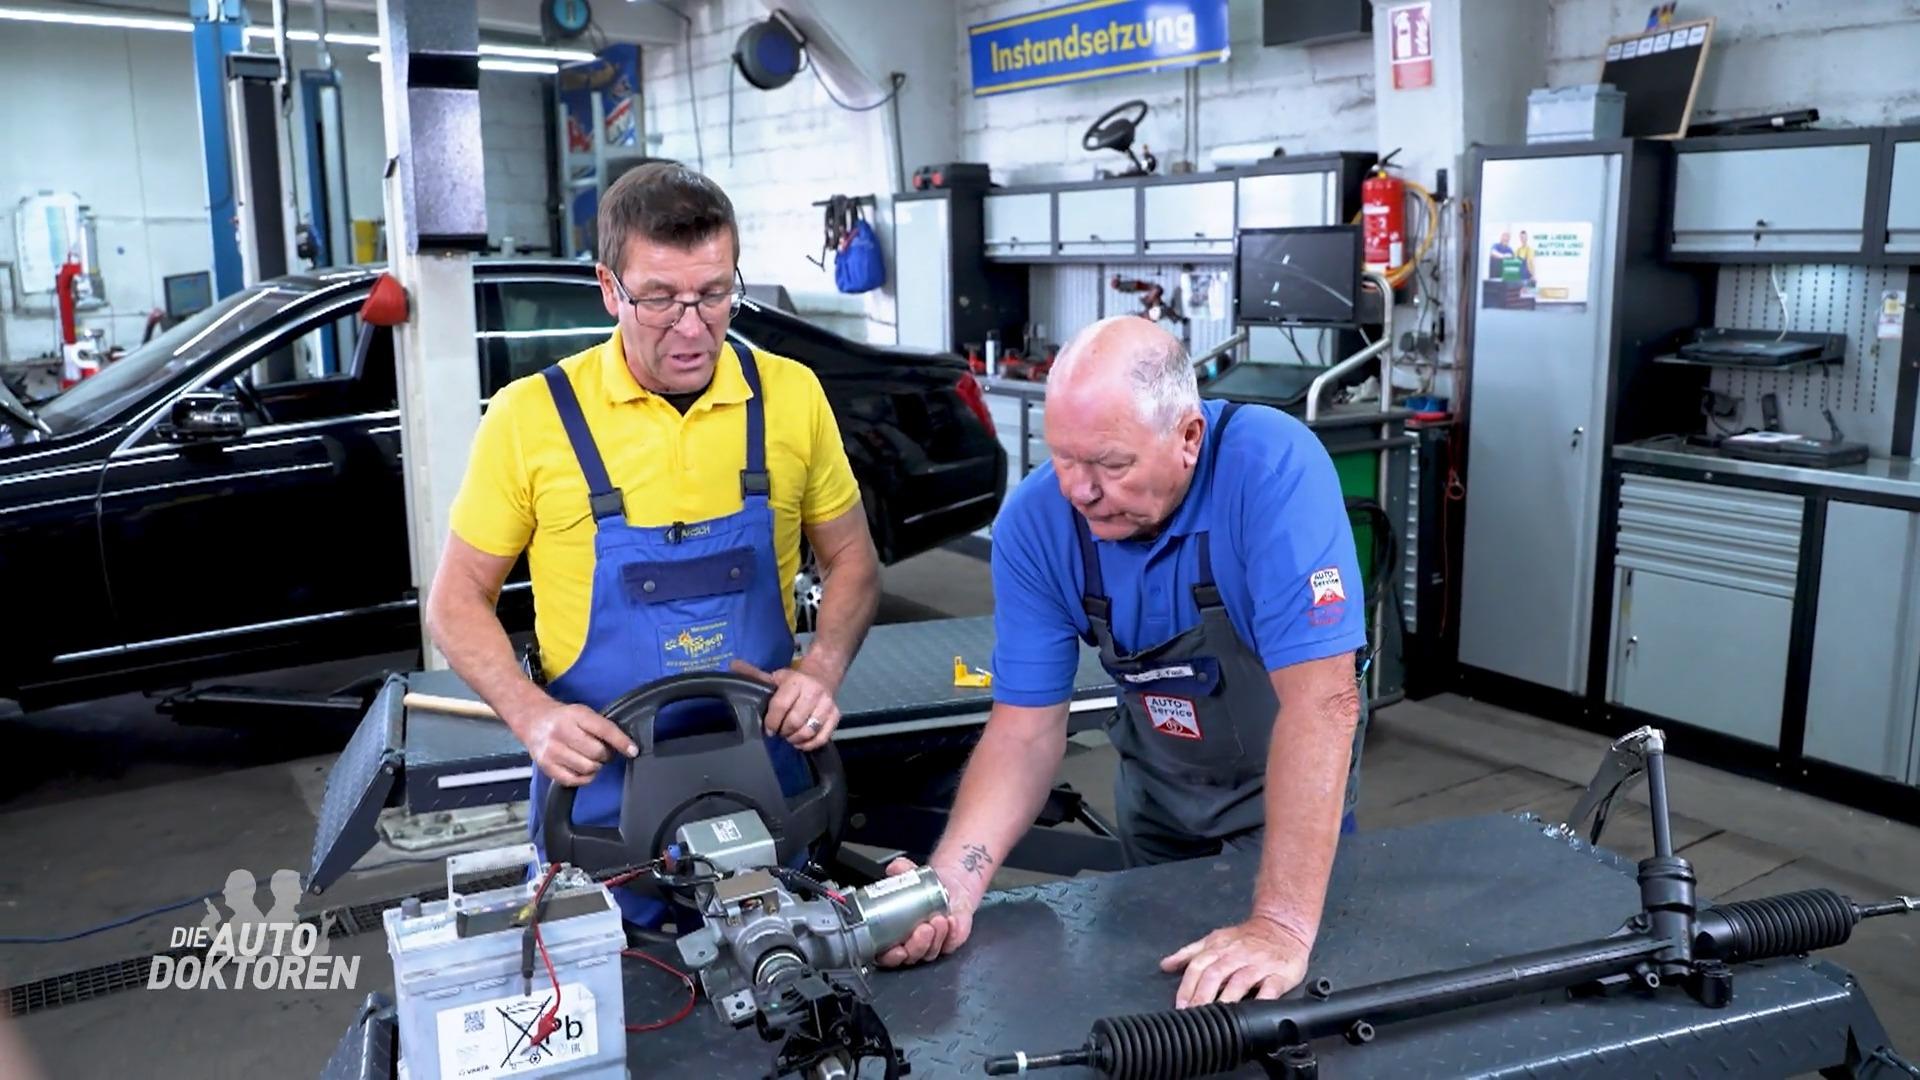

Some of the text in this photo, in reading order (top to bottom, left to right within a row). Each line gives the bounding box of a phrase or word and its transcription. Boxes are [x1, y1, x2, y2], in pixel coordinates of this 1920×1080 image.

[991, 13, 1195, 72] Instandsetzung
[1151, 698, 1188, 709] AUTO-
[1150, 705, 1192, 718] Service
